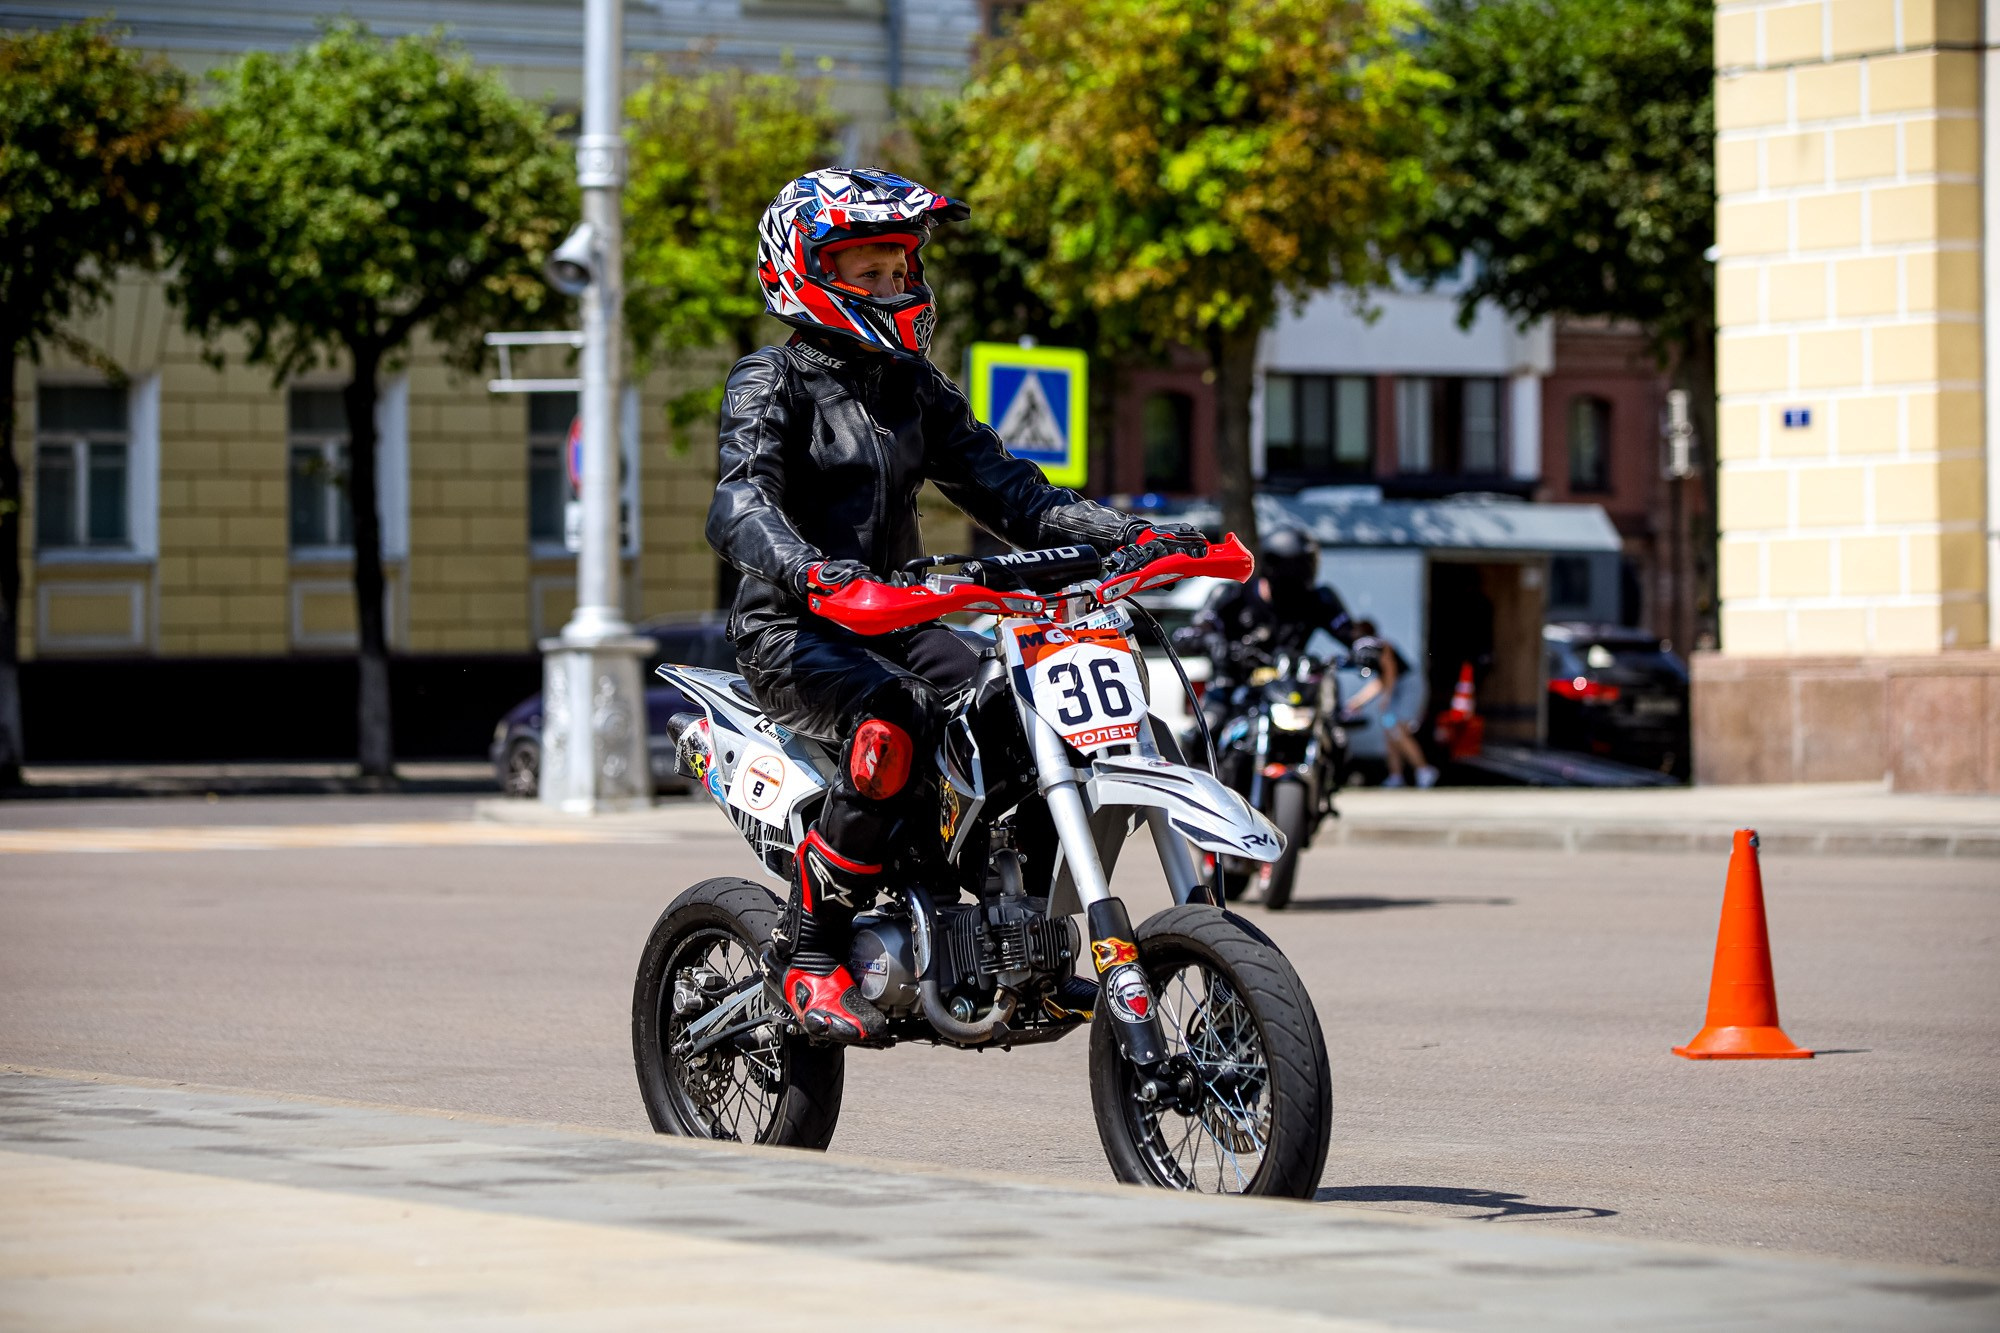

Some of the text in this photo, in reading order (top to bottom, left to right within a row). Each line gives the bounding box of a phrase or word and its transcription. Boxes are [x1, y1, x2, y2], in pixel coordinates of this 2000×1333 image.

[795, 342, 846, 369] DAINESE
[995, 547, 1080, 566] MOTO
[1090, 612, 1117, 627] JUST
[1095, 617, 1121, 630] OTO
[1048, 658, 1132, 726] 36
[764, 729, 786, 744] MOTO
[752, 781, 765, 797] 8
